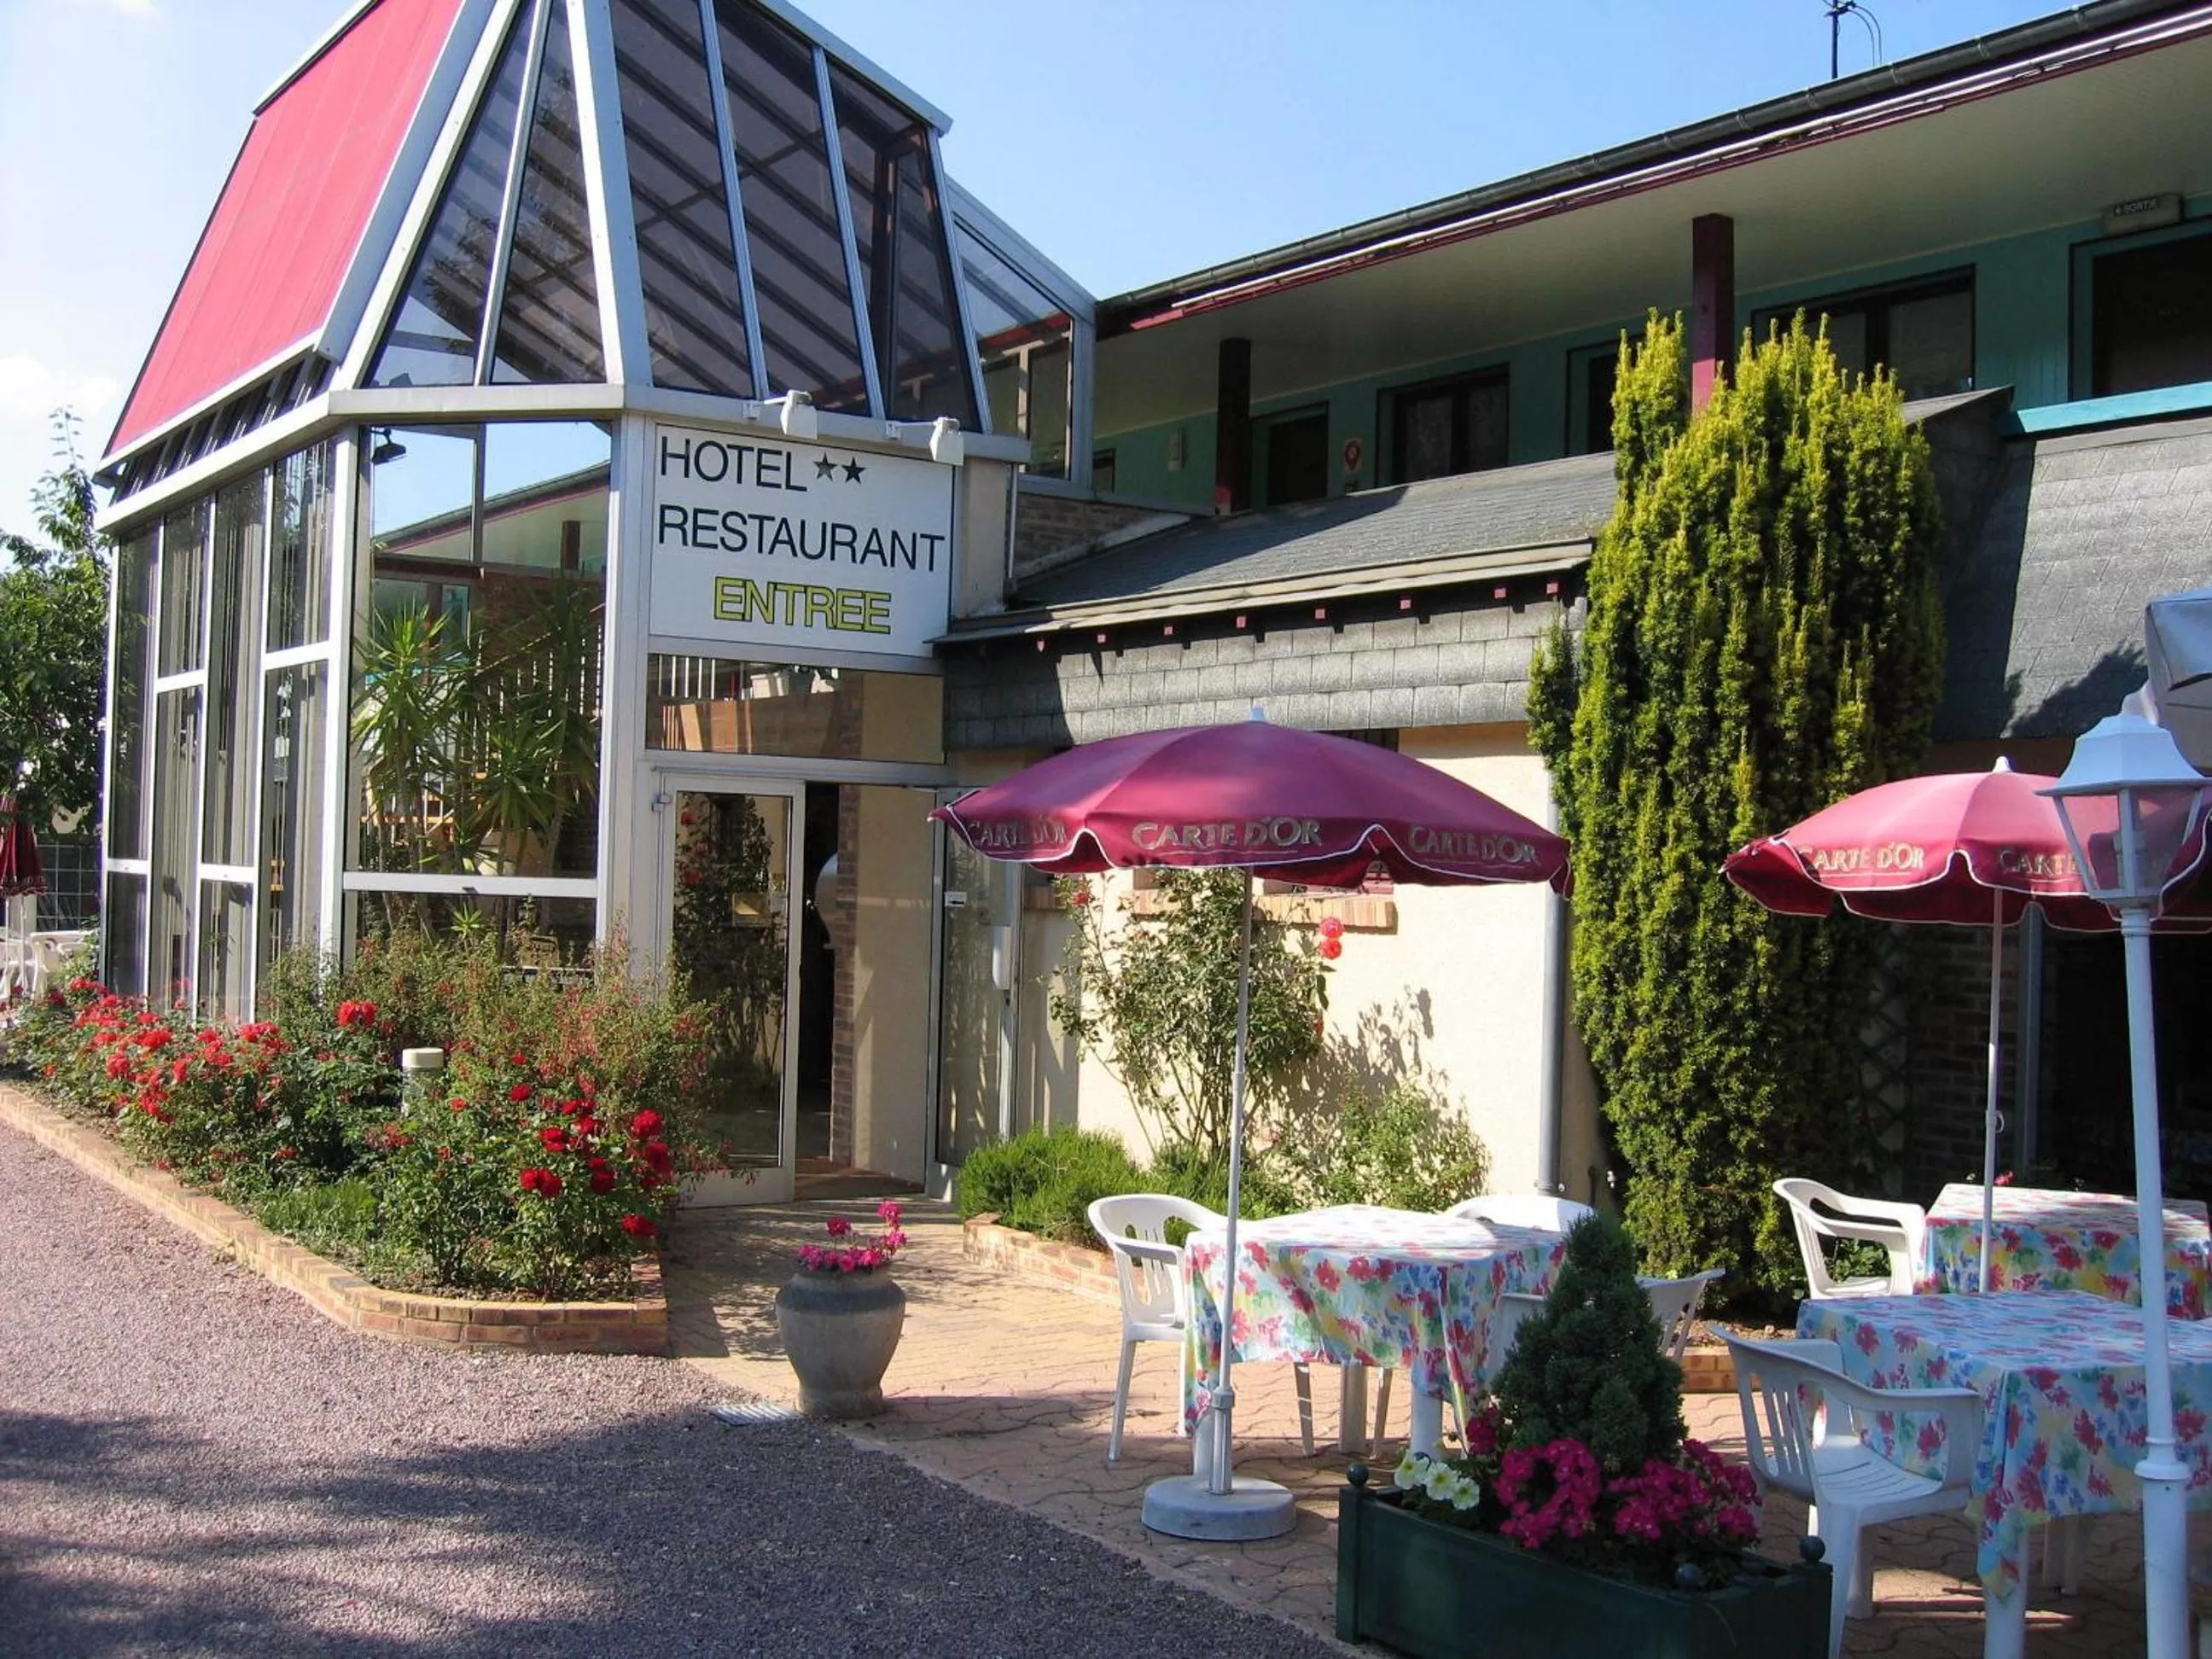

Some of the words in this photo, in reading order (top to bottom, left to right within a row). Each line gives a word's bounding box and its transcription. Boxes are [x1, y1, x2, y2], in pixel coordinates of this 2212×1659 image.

[660, 435, 808, 492] HOTEL
[658, 504, 946, 572] RESTAURANT
[713, 576, 892, 635] ENTREE
[1132, 821, 1238, 851] CARTE
[1244, 815, 1323, 847] D'OR
[1408, 824, 1479, 856] CARTE
[1481, 833, 1543, 867] D'OR
[1877, 841, 1926, 870] D'OR
